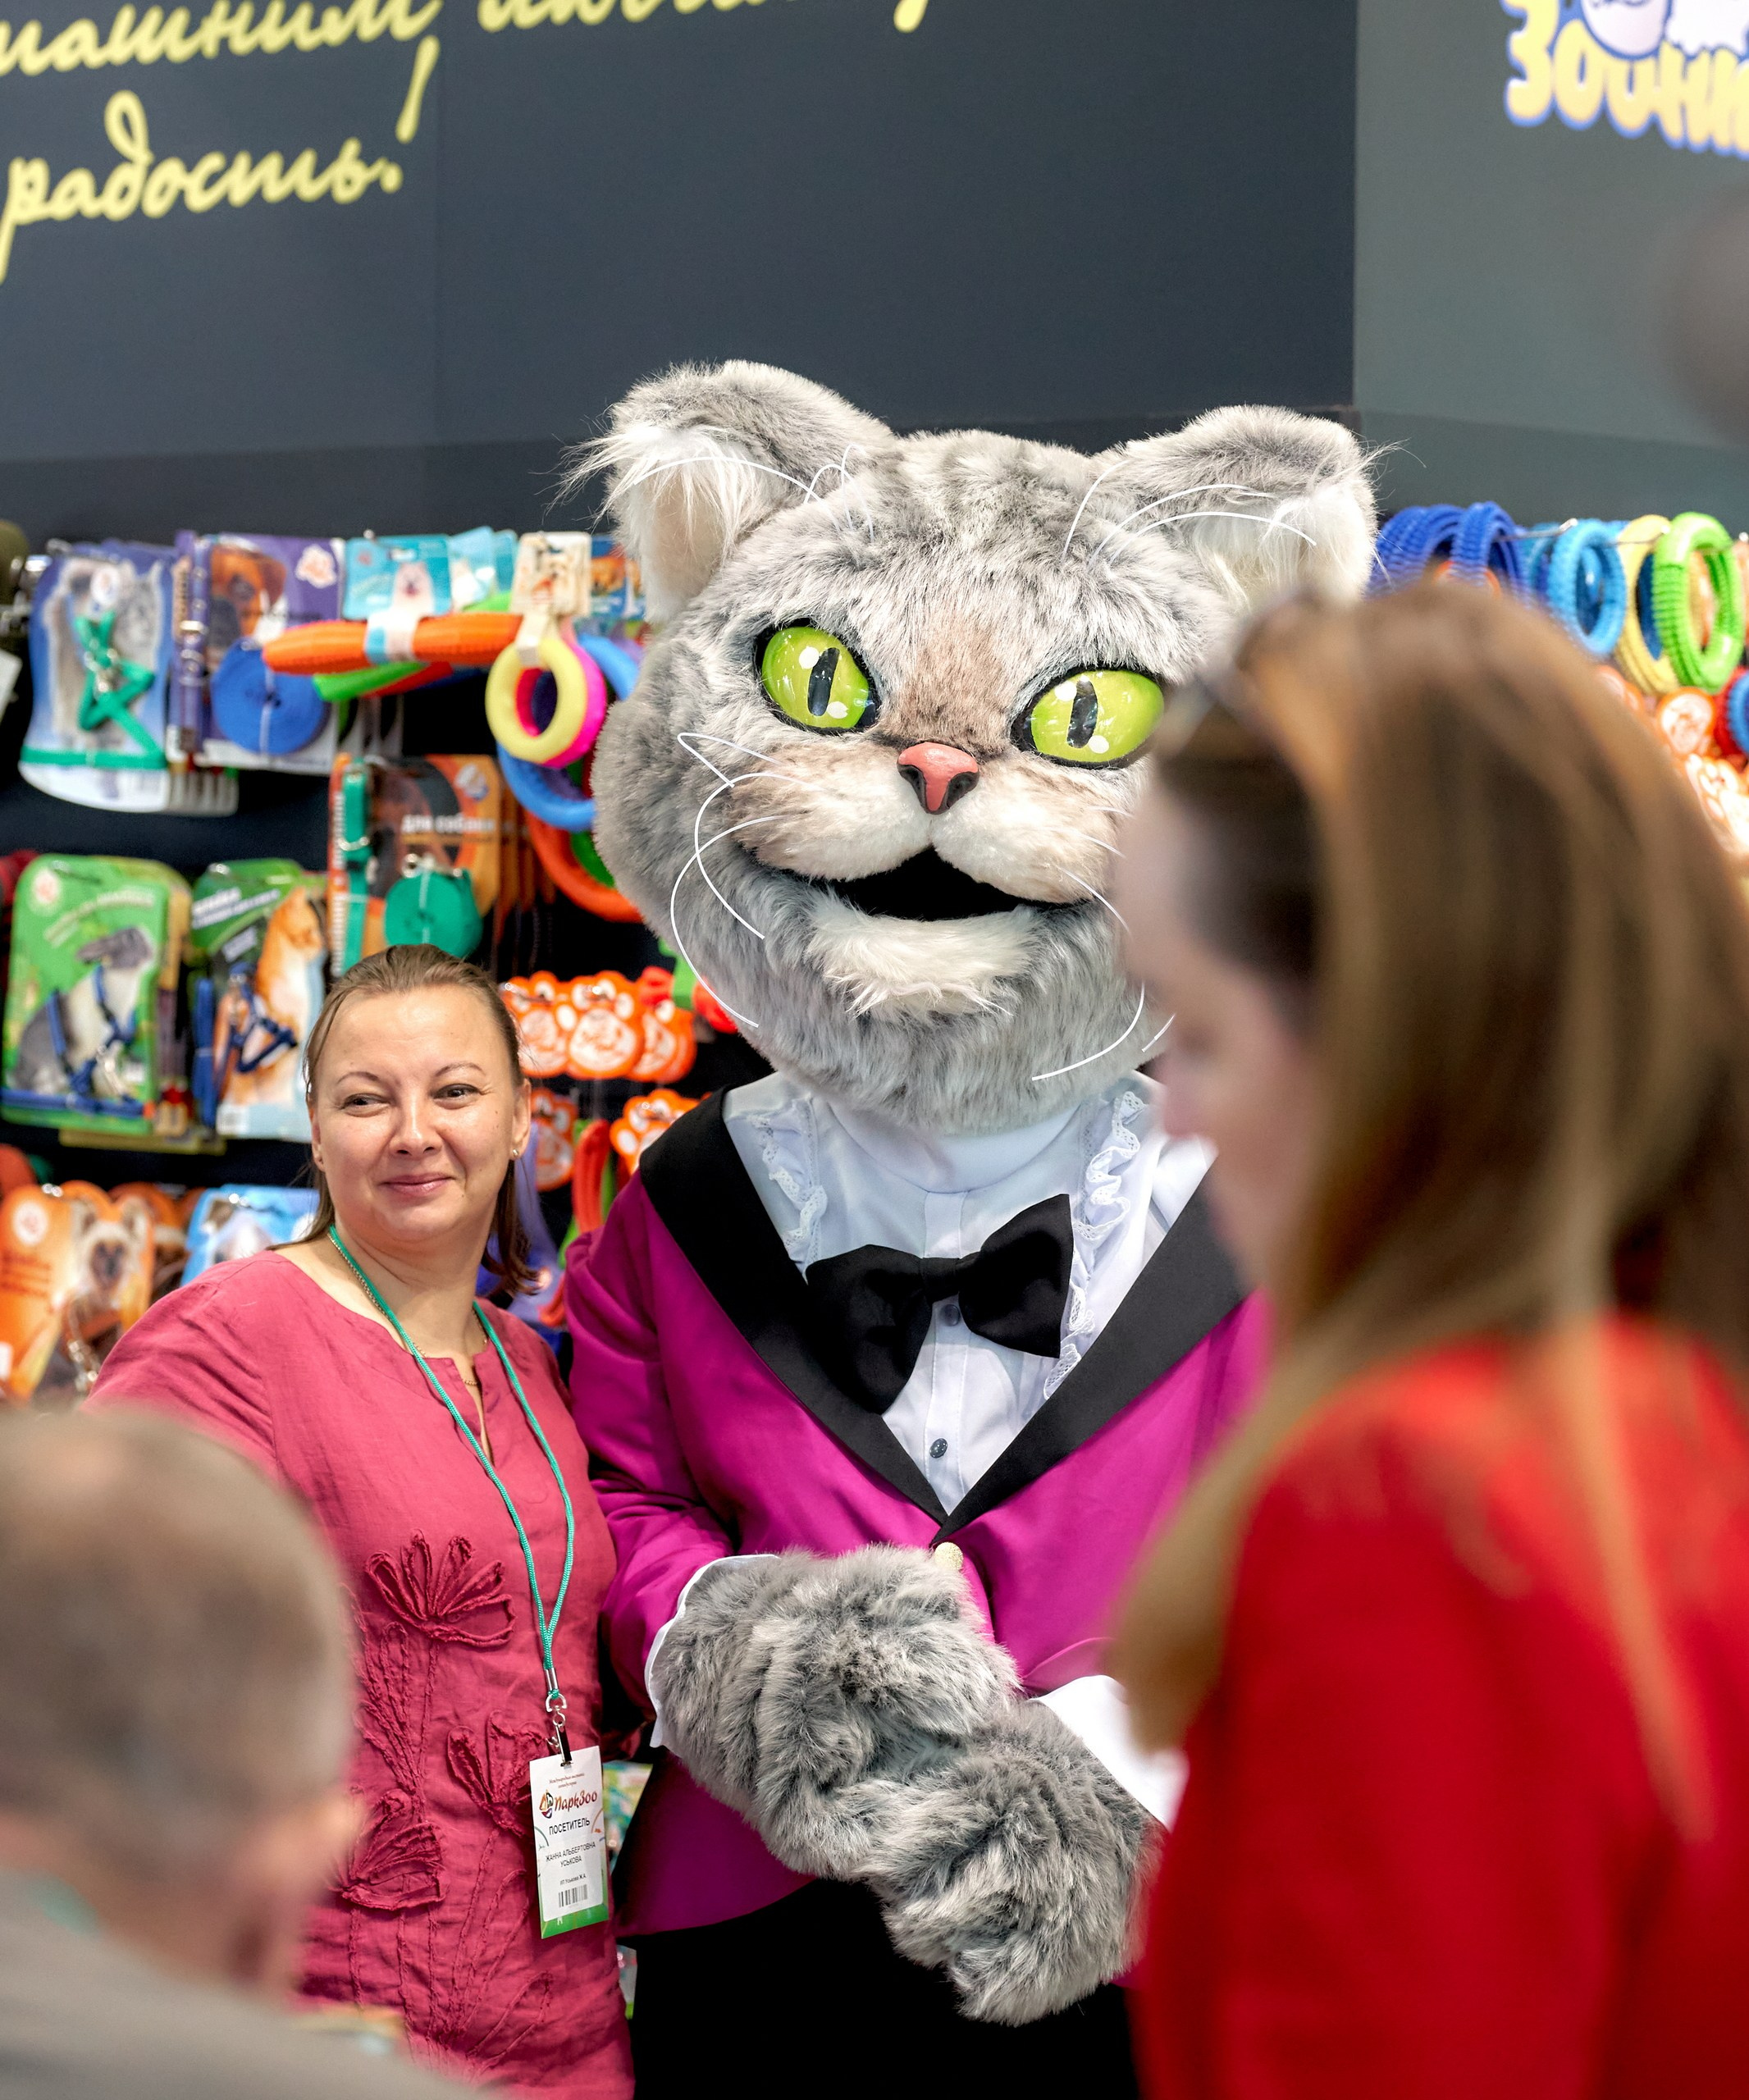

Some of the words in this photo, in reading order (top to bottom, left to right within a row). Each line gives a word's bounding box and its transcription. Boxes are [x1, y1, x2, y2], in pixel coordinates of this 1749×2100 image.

[549, 1817, 591, 1835] ПОСЕТИТЕЛЬ
[546, 1851, 562, 1862] ЖАННА
[563, 1842, 596, 1857] АЛЬБЕРТОВНА
[560, 1856, 582, 1867] УСЬКОВА
